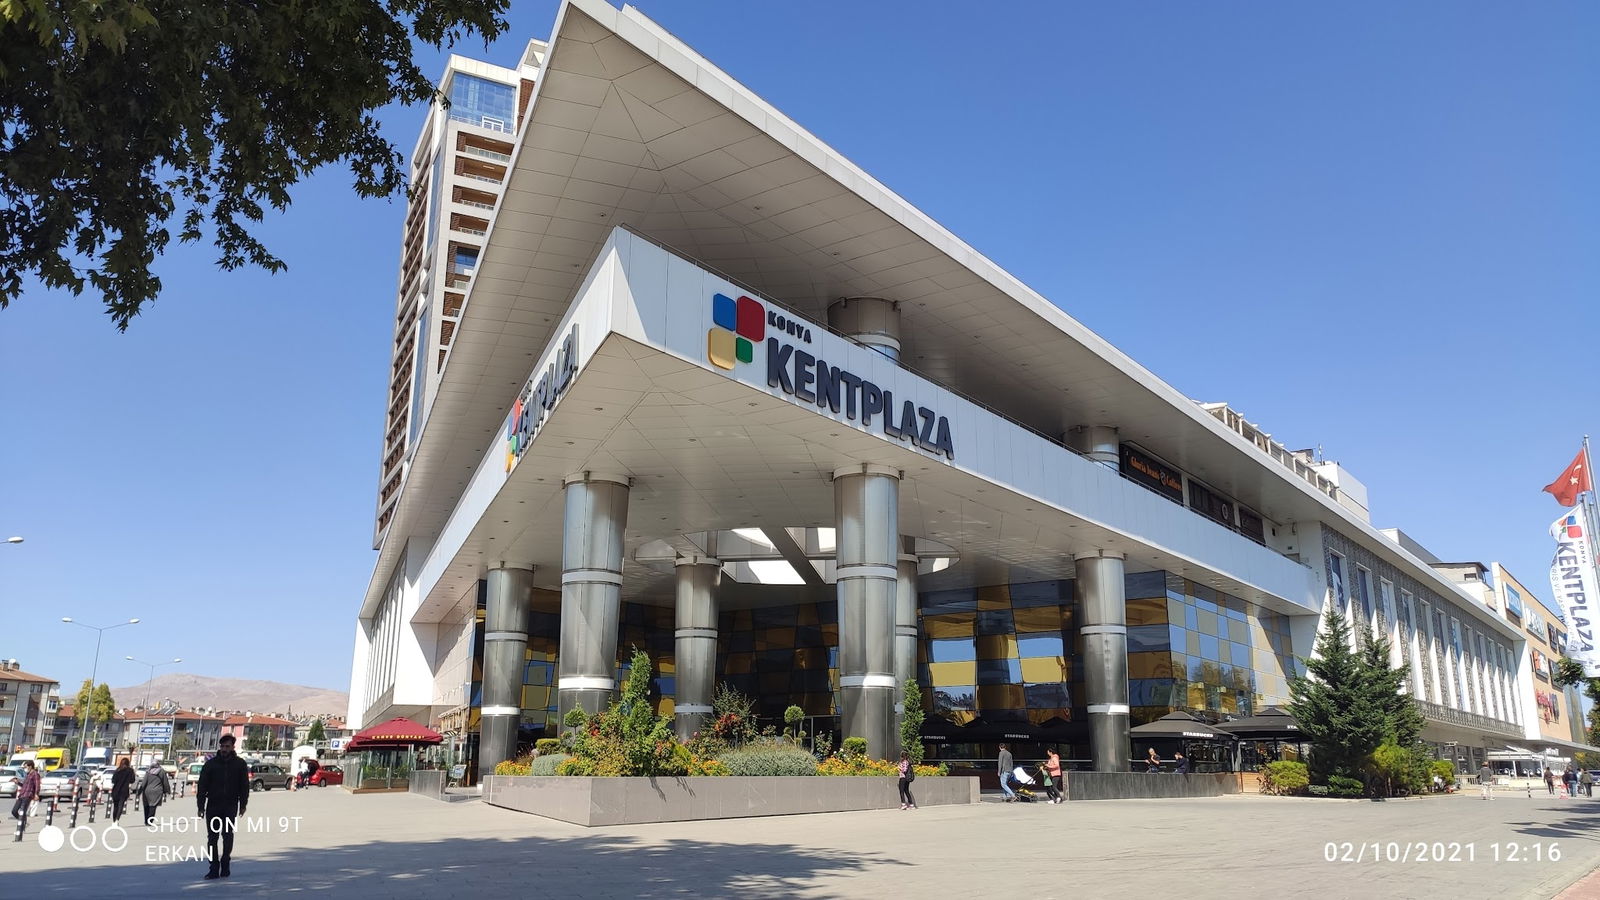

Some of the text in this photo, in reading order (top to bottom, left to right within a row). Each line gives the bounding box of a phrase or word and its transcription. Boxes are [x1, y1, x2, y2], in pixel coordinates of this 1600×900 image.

[768, 310, 812, 344] KONYA
[767, 336, 955, 460] KENTPLAZA
[1557, 541, 1594, 652] KENTPLAZA
